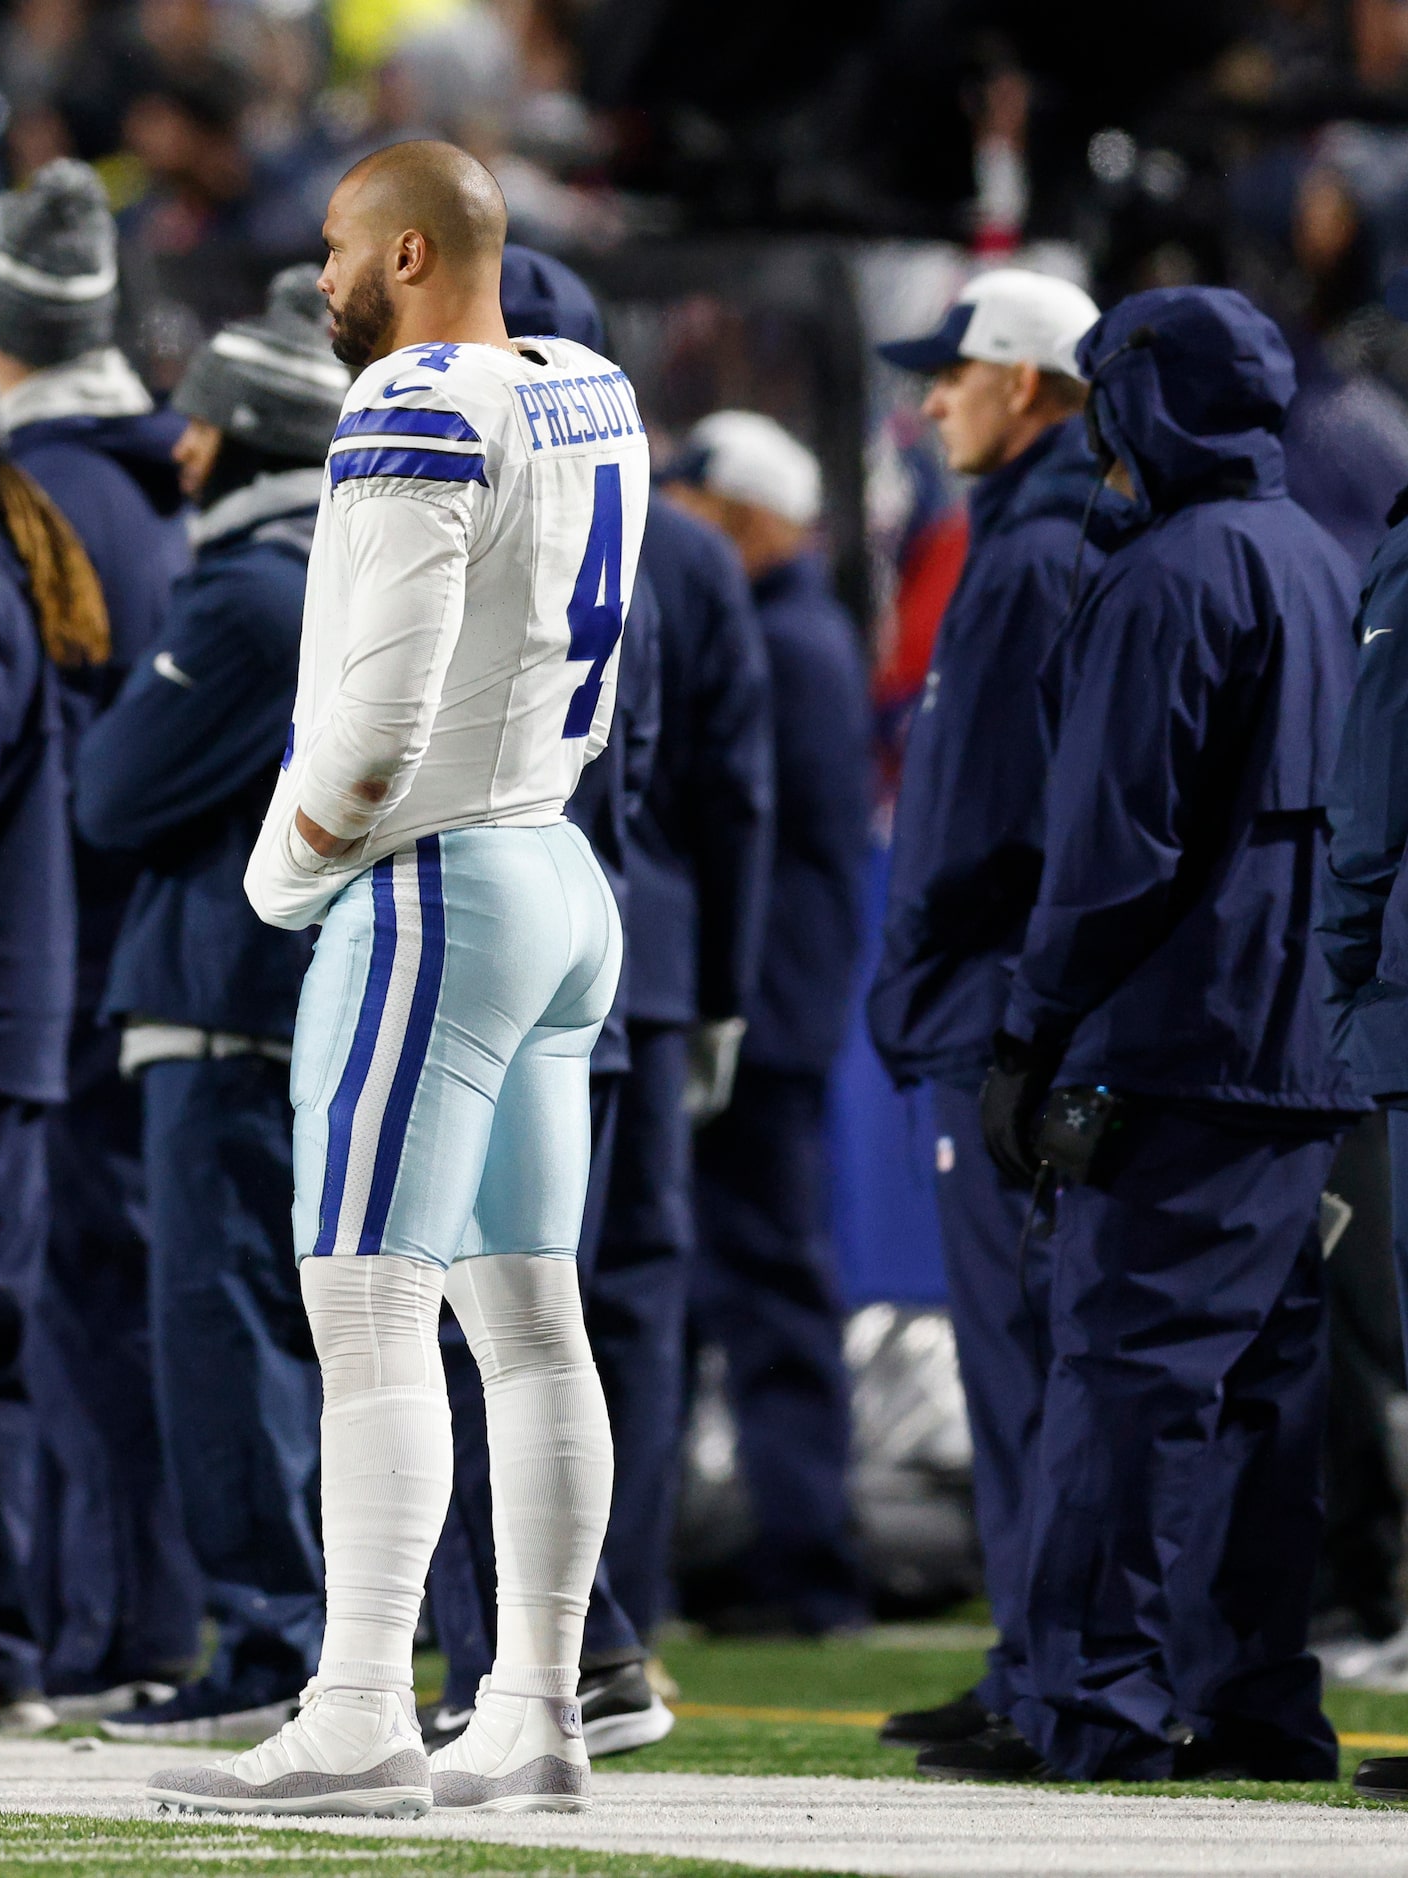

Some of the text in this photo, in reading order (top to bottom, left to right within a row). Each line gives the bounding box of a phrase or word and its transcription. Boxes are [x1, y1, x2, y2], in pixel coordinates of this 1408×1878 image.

[402, 341, 462, 373] 4
[514, 370, 646, 451] PRESCOTT
[561, 463, 624, 739] 4
